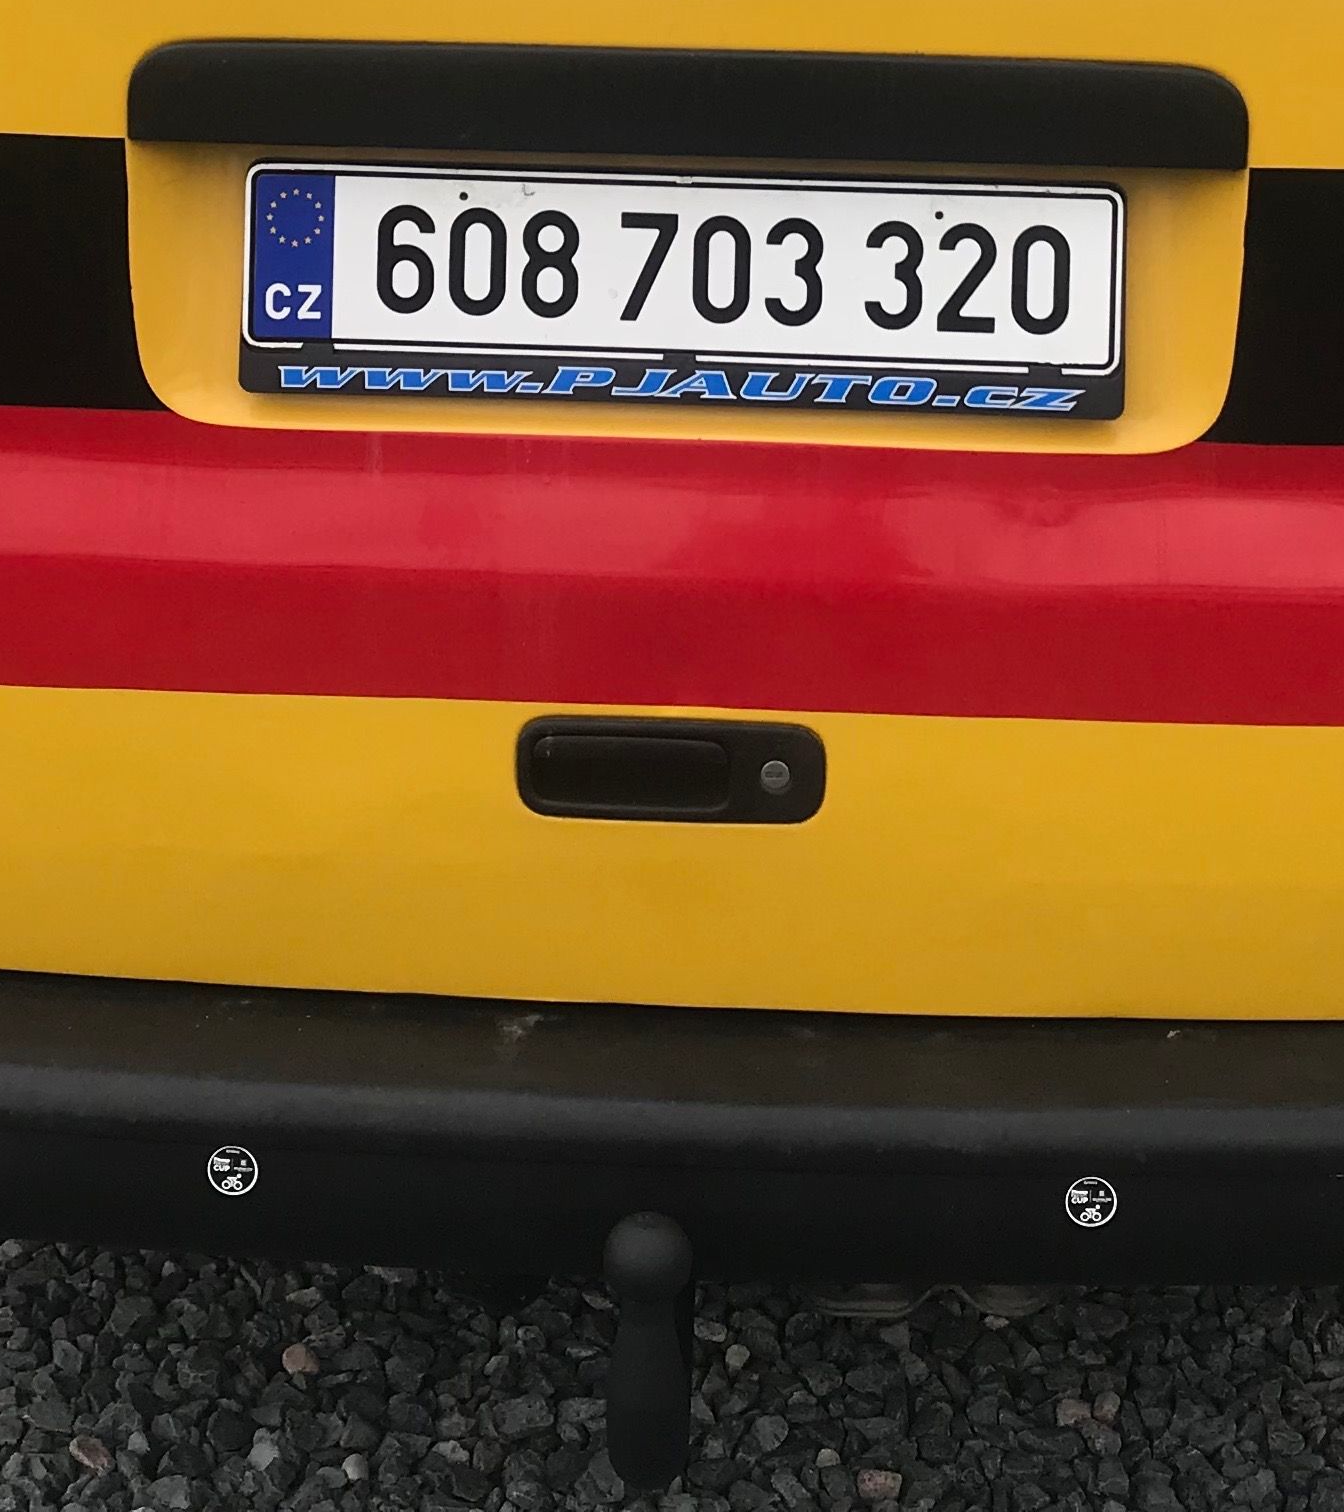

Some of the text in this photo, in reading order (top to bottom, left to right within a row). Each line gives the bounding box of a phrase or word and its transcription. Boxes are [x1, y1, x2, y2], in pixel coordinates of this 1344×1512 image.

[264, 283, 322, 321] CZ
[376, 204, 1071, 335] 608 703 320
